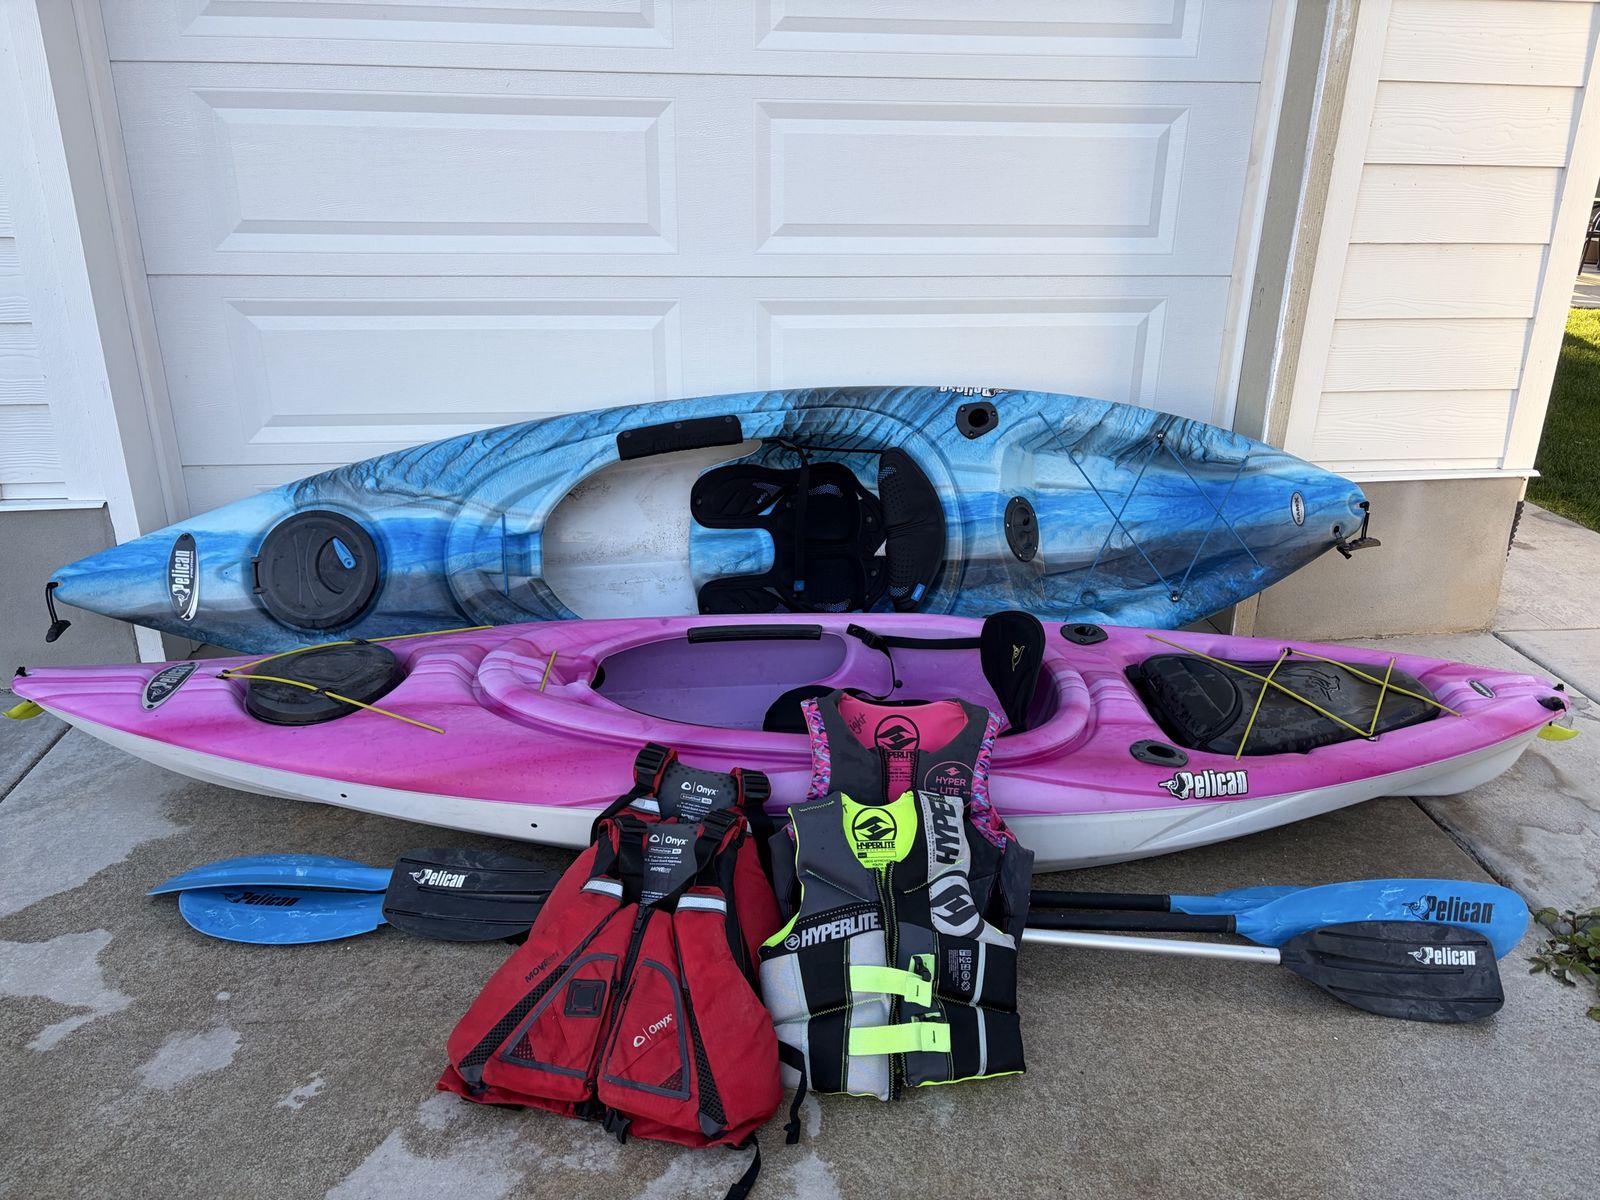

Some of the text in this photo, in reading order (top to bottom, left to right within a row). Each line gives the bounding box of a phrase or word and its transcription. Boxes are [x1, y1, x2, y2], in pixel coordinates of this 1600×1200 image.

[172, 550, 190, 592] Pelican
[150, 665, 195, 691] Pelican
[696, 784, 717, 796] Onyx
[936, 776, 966, 787] HYPER
[940, 786, 960, 796] LITE
[1181, 769, 1248, 799] Pelican
[665, 835, 686, 847] Onyx
[856, 840, 896, 849] HYPERLITE
[420, 869, 466, 888] Pelican
[240, 892, 301, 907] Pelican
[1423, 895, 1493, 924] Pelican
[801, 911, 879, 948] HYPERLITE
[1423, 946, 1476, 966] Pelican
[648, 1013, 673, 1035] Onyx
